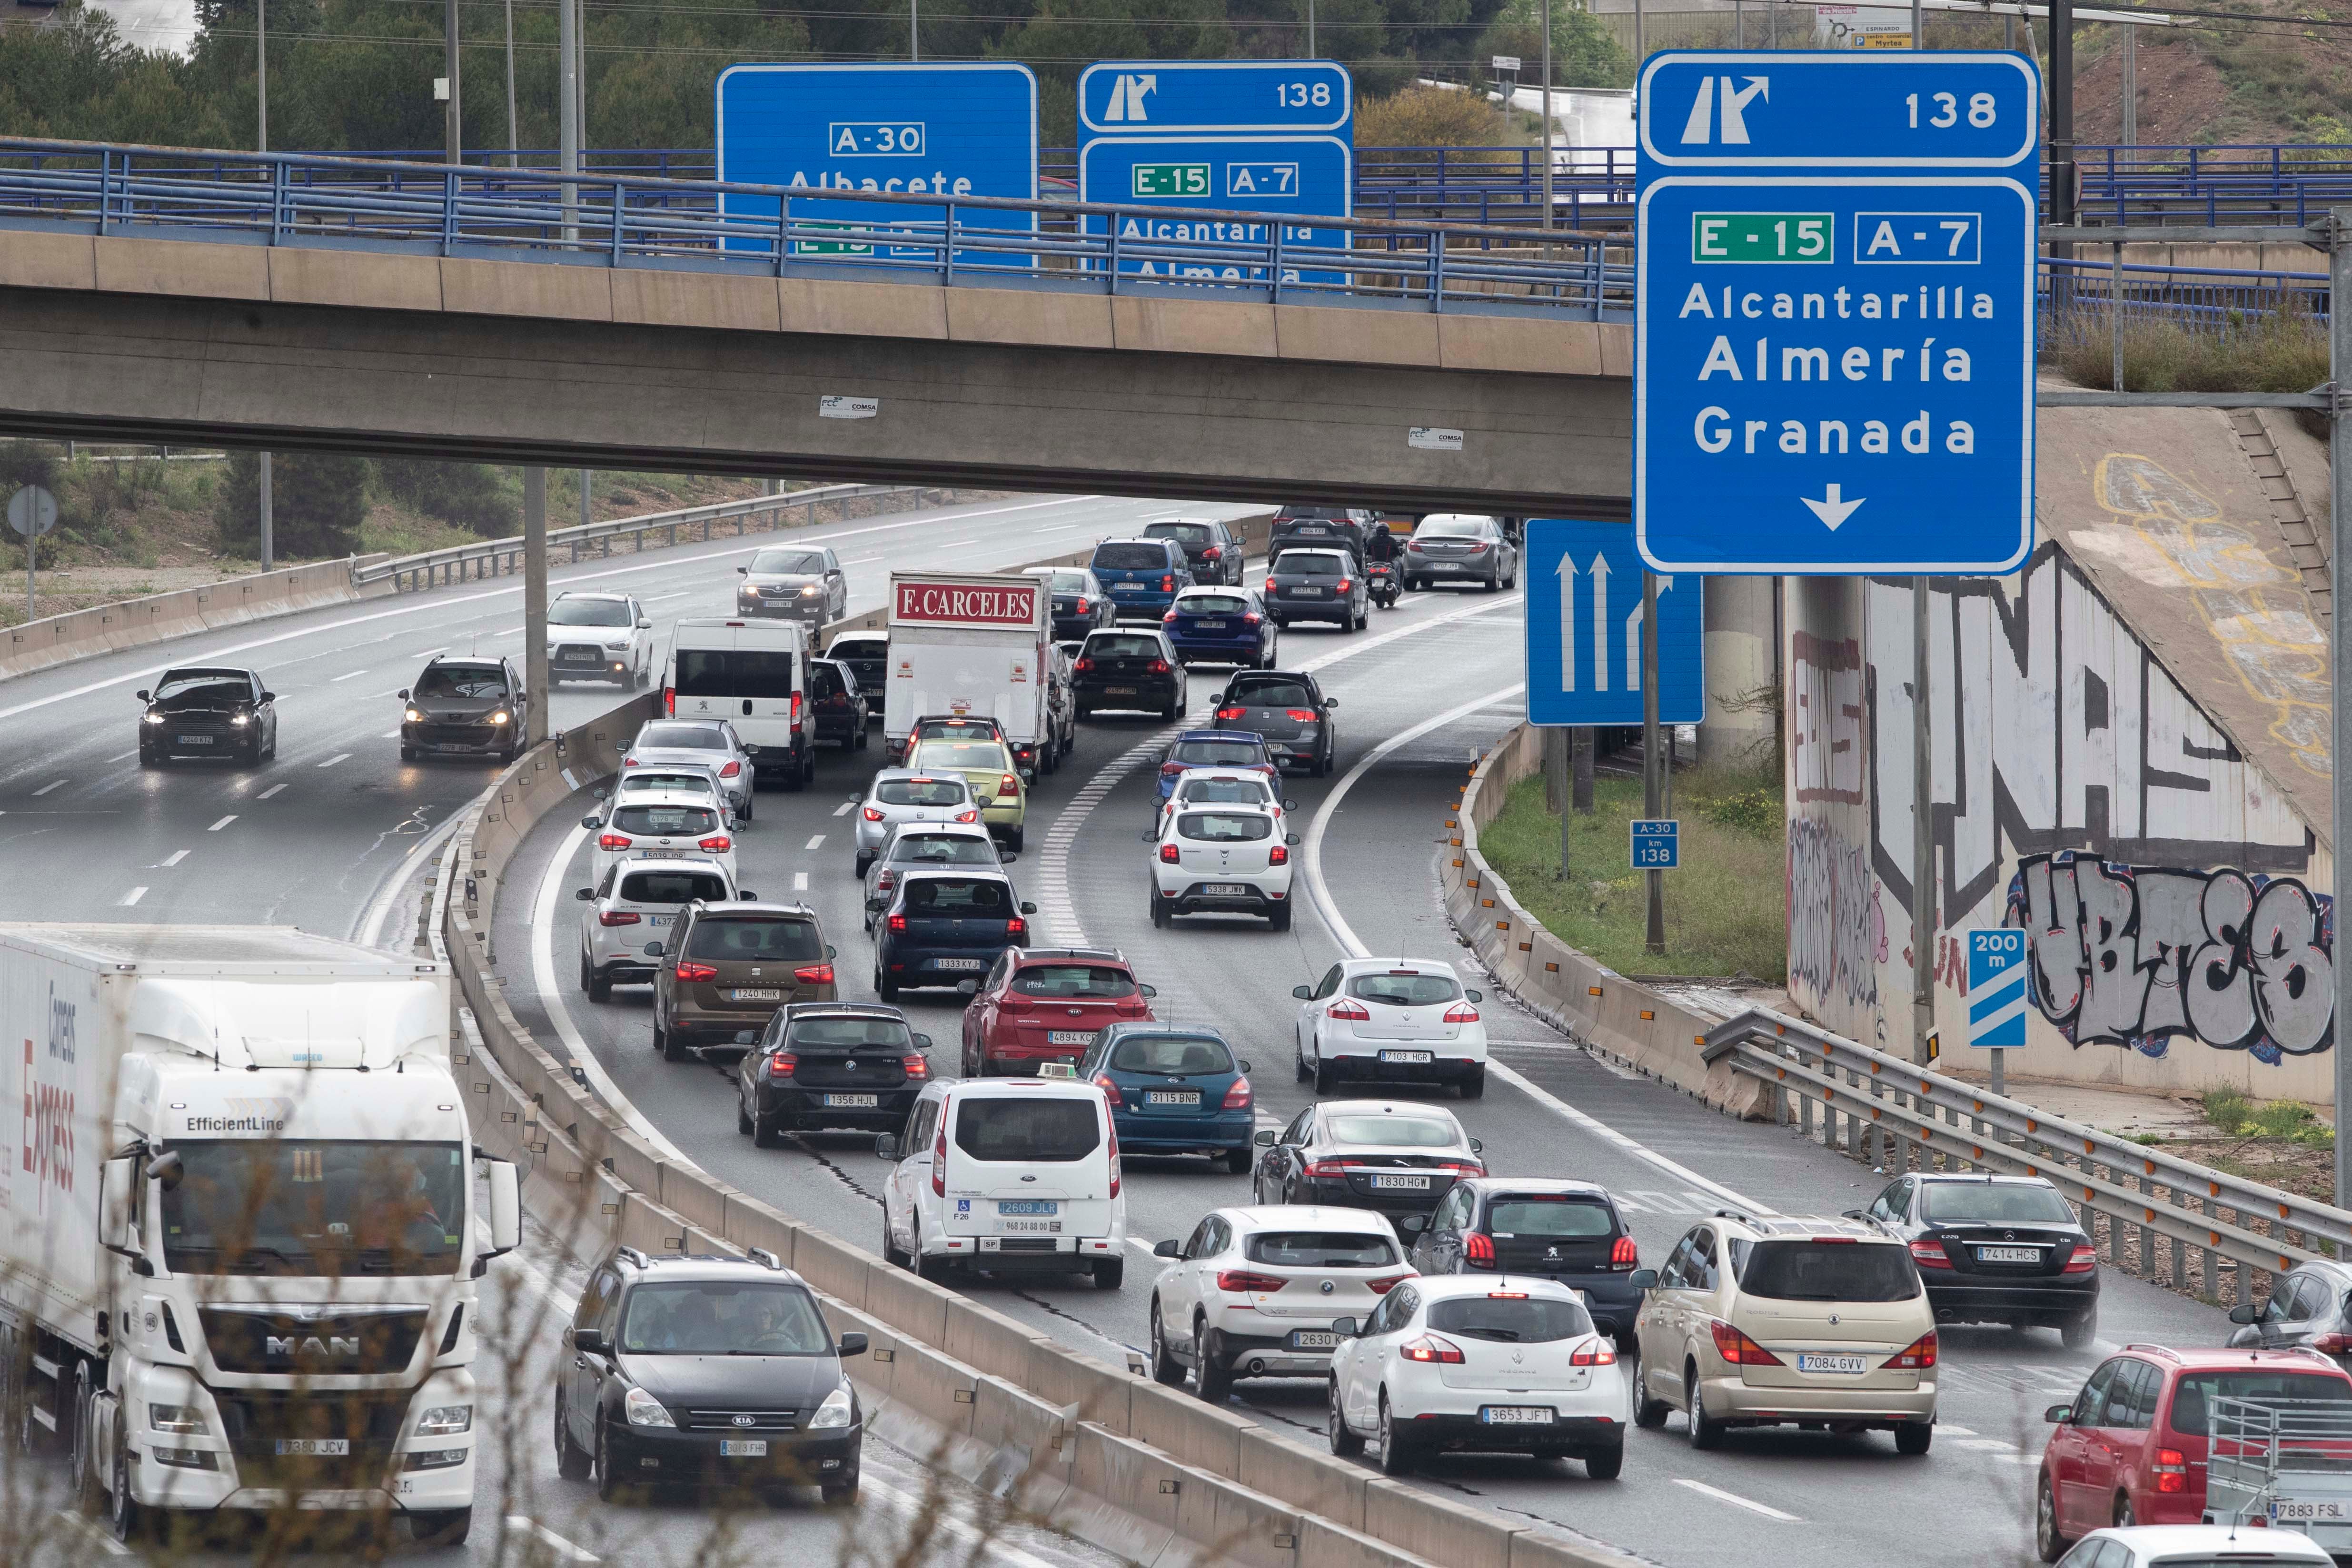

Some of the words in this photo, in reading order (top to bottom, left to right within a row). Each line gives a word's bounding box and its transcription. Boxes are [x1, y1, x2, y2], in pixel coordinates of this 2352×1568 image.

[1277, 83, 1330, 107] 138
[1905, 91, 1997, 129] 138
[835, 127, 920, 151] A-30
[1138, 169, 1205, 192] E-15
[1233, 168, 1293, 191] A-7
[1679, 282, 1994, 319] Alcantarilla
[1697, 335, 1972, 383] Almería
[1694, 405, 1975, 455] Granada
[903, 589, 919, 614] F.
[923, 589, 1030, 619] CARCELES
[1640, 824, 1670, 833] A-30
[1641, 849, 1670, 862] 138
[1975, 934, 2018, 952] 200
[941, 960, 960, 968] 1333
[963, 960, 977, 968] KYJ
[1989, 955, 2005, 967] m
[738, 990, 758, 998] 1240
[762, 990, 778, 998] HHK
[49, 979, 76, 1065] Correos
[1054, 1033, 1077, 1042] 4894
[1387, 1052, 1407, 1061] 7103
[1413, 1053, 1428, 1062] HGR
[832, 1096, 853, 1104] 1356
[857, 1097, 874, 1105] HJL
[1152, 1094, 1176, 1102] 3115
[1179, 1094, 1197, 1103] BNR
[23, 1038, 75, 1215] Express
[188, 1117, 284, 1130] EfficientLine
[1380, 1176, 1405, 1186] 1830
[1408, 1177, 1427, 1186] HGW
[1005, 1203, 1032, 1212] 2609
[1036, 1203, 1056, 1213] JLR
[1006, 1221, 1018, 1231] 968
[1020, 1222, 1028, 1231] 24
[1029, 1222, 1038, 1231] 88
[1039, 1222, 1047, 1231] 00
[1985, 1249, 2013, 1258] 7414
[2016, 1250, 2037, 1260] HCS
[1302, 1334, 1331, 1345] 2630
[267, 1337, 359, 1355] MAN
[1807, 1357, 1836, 1369] 7084
[1840, 1358, 1862, 1370] GVV
[1492, 1409, 1522, 1420] 3653
[1527, 1411, 1549, 1421] JFT
[322, 1441, 344, 1453] JCV
[750, 1444, 765, 1453] FHR
[2279, 1505, 2313, 1517] 7883
[2318, 1505, 2343, 1517] FSL
